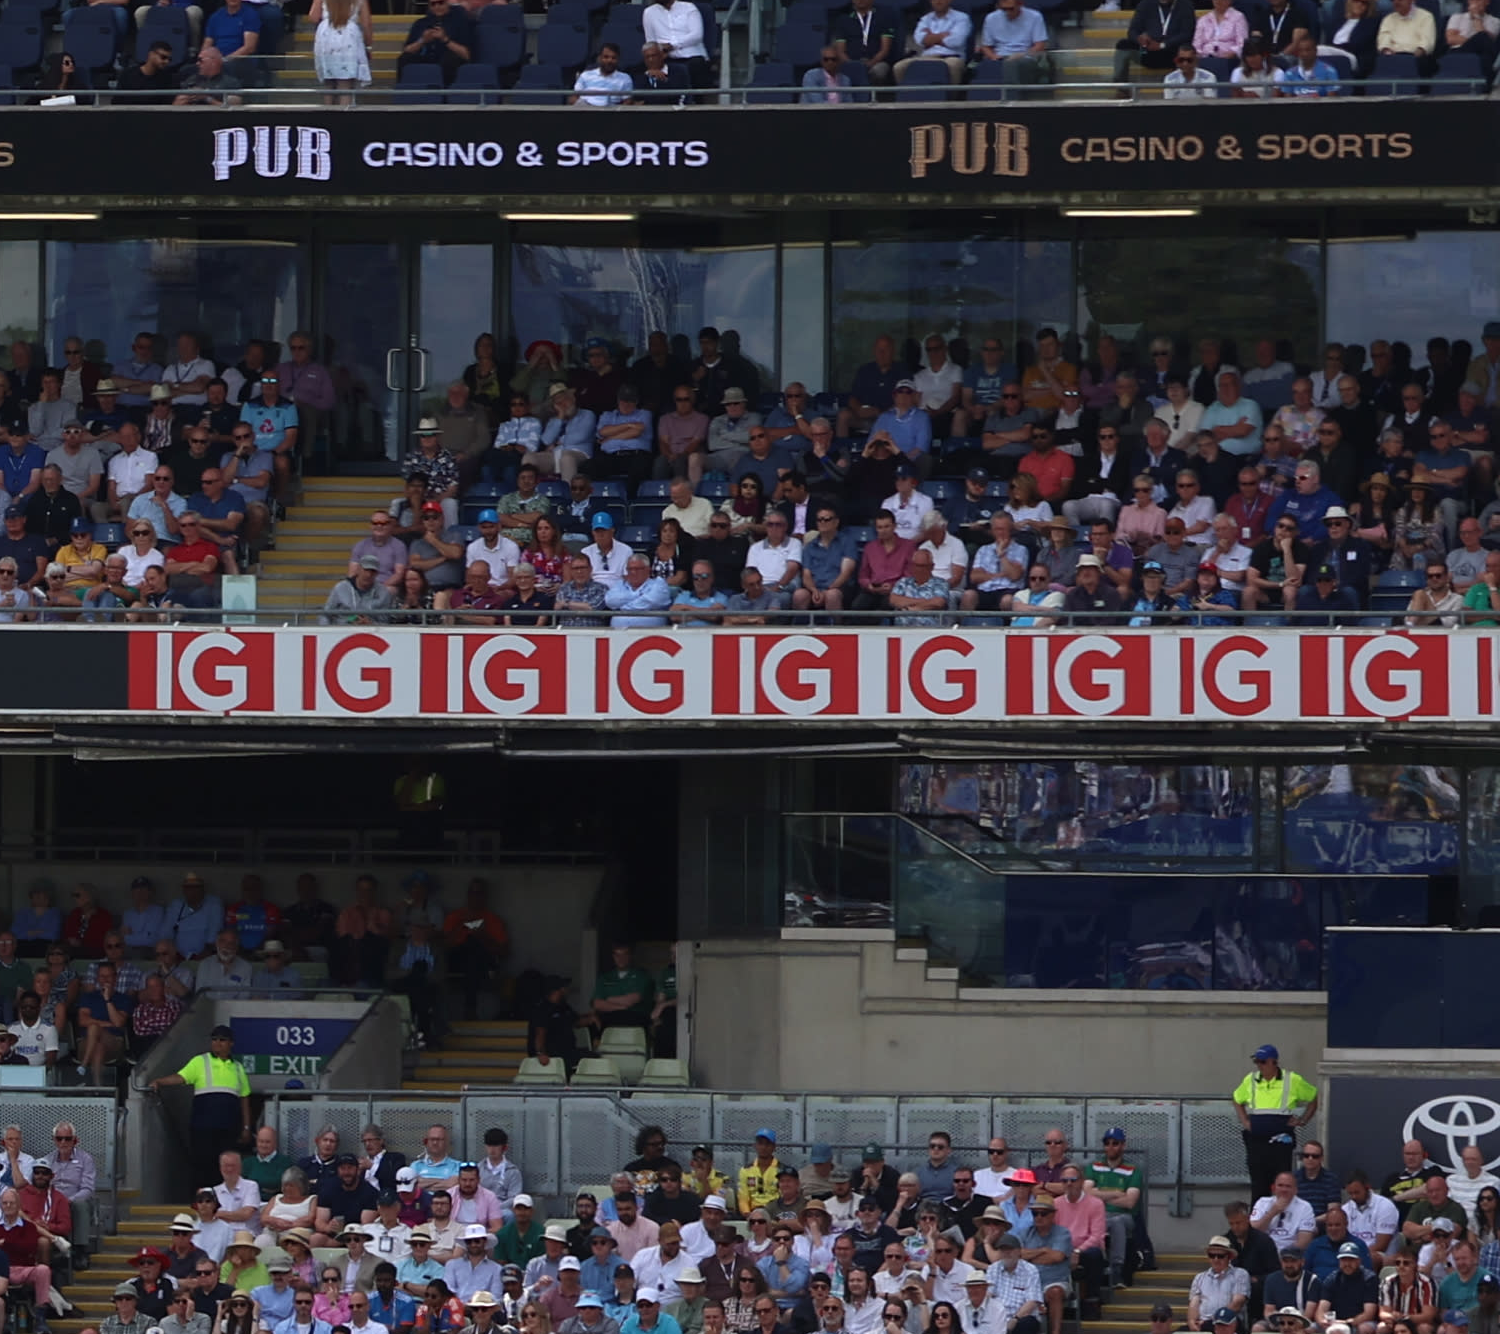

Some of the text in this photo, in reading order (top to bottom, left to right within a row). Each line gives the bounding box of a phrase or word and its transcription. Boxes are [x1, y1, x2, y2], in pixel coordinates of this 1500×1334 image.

[212, 126, 709, 180] PUB CASINO & SPORTS
[909, 123, 1412, 178] PUB CASINO & SPORTS
[157, 633, 247, 711] IG
[302, 633, 391, 713] IG
[447, 635, 540, 715] IG
[595, 636, 684, 715] IG
[739, 636, 830, 715] IG
[887, 635, 977, 715] IG
[1032, 635, 1123, 715] IG
[1180, 635, 1271, 715] IG
[1328, 635, 1421, 717] IG
[269, 1056, 322, 1075] EXIT
[276, 1026, 315, 1046] 033
